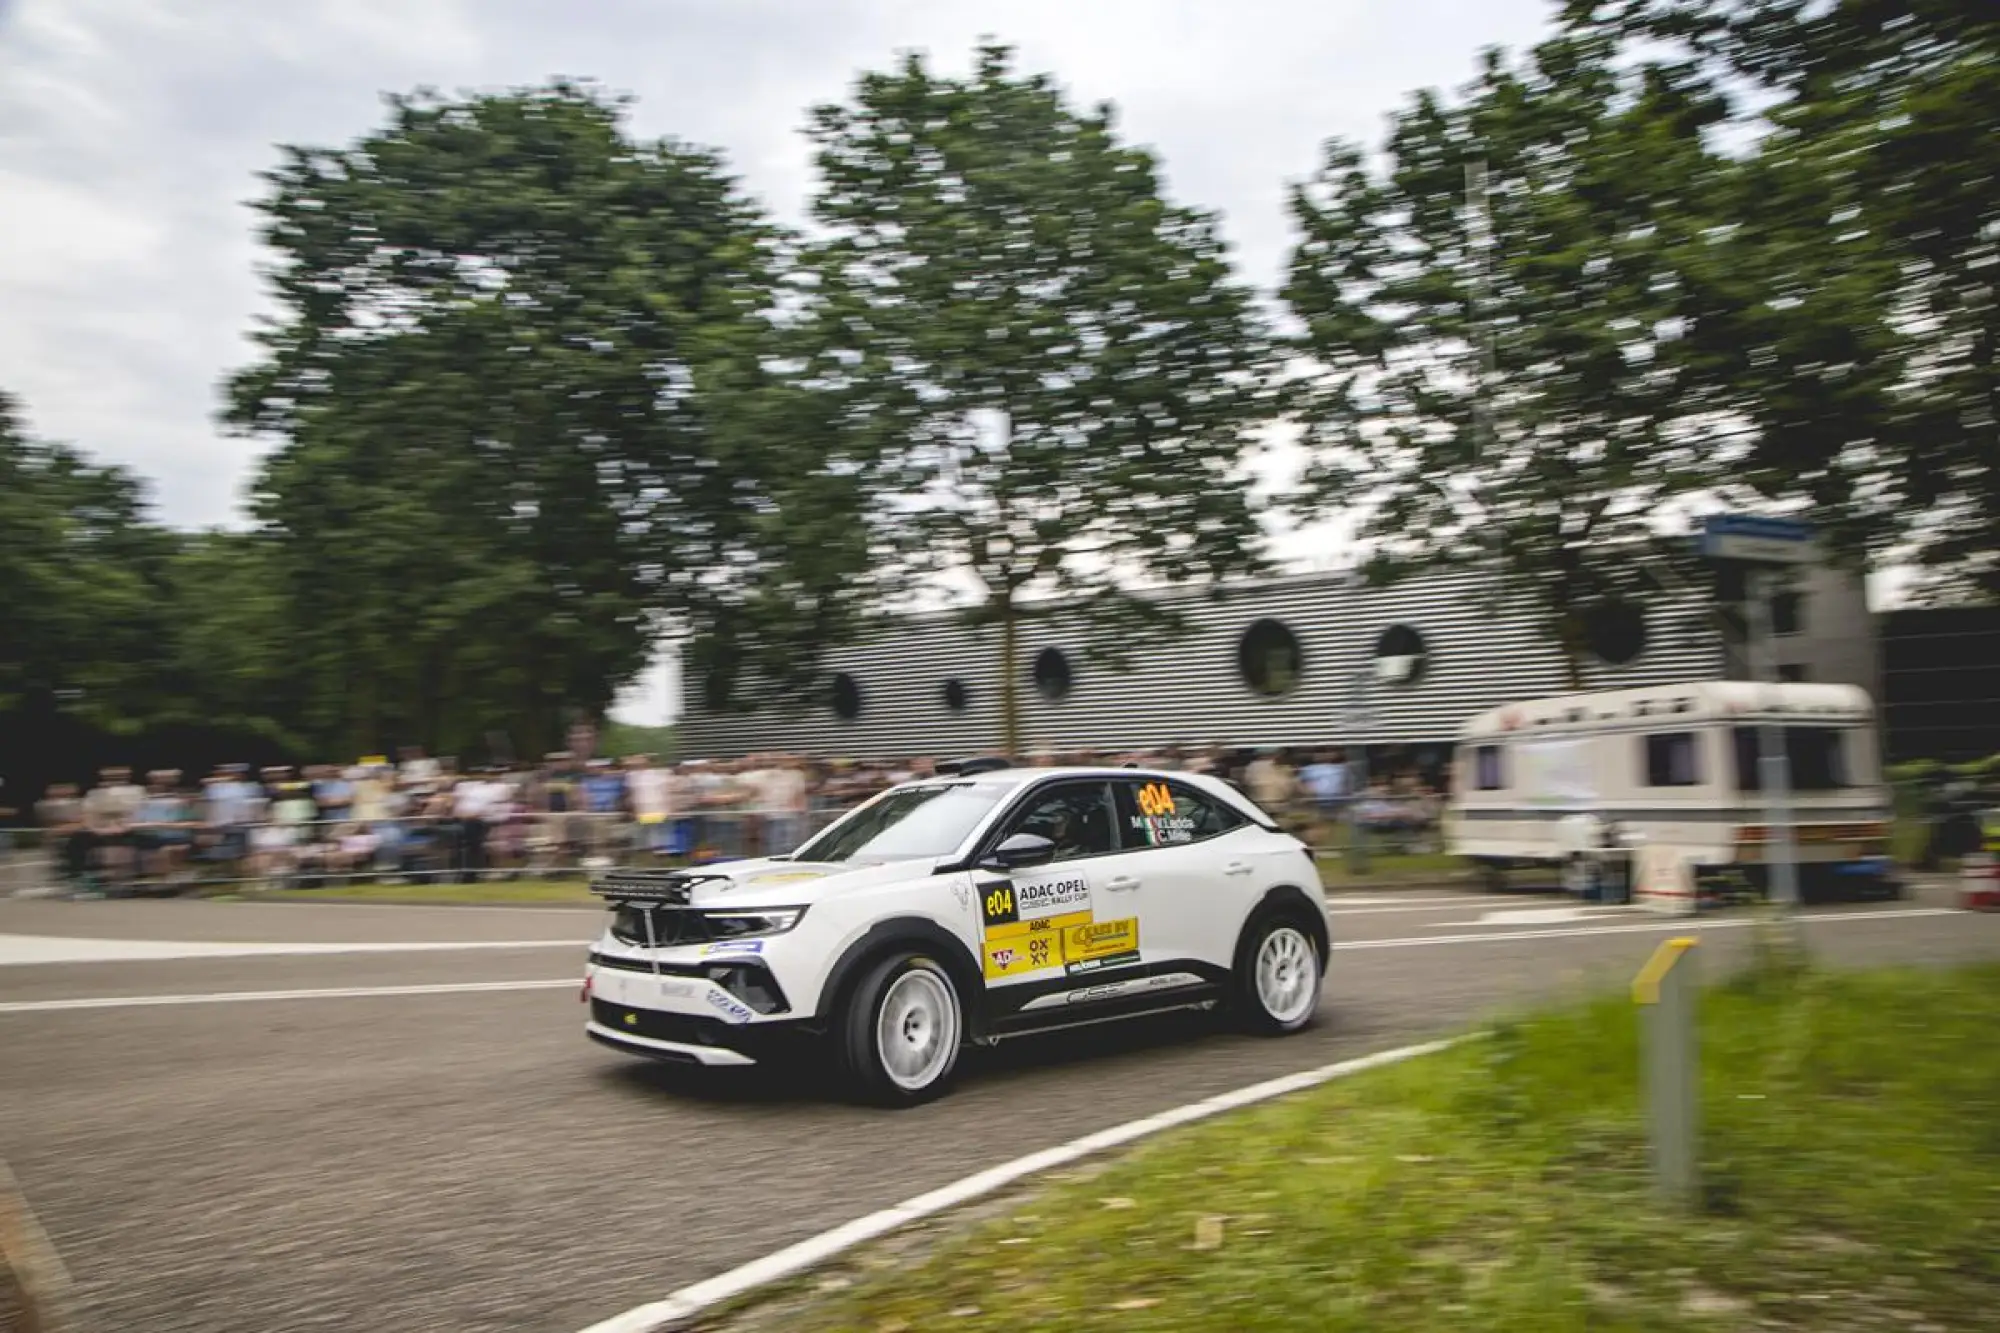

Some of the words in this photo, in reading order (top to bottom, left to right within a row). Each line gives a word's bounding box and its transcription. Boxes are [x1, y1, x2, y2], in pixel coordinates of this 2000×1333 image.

[1138, 784, 1174, 814] e04
[1020, 883, 1053, 900] ADAC
[1056, 880, 1087, 894] OPEL
[987, 889, 1012, 916] e04
[1029, 919, 1051, 931] ADAC
